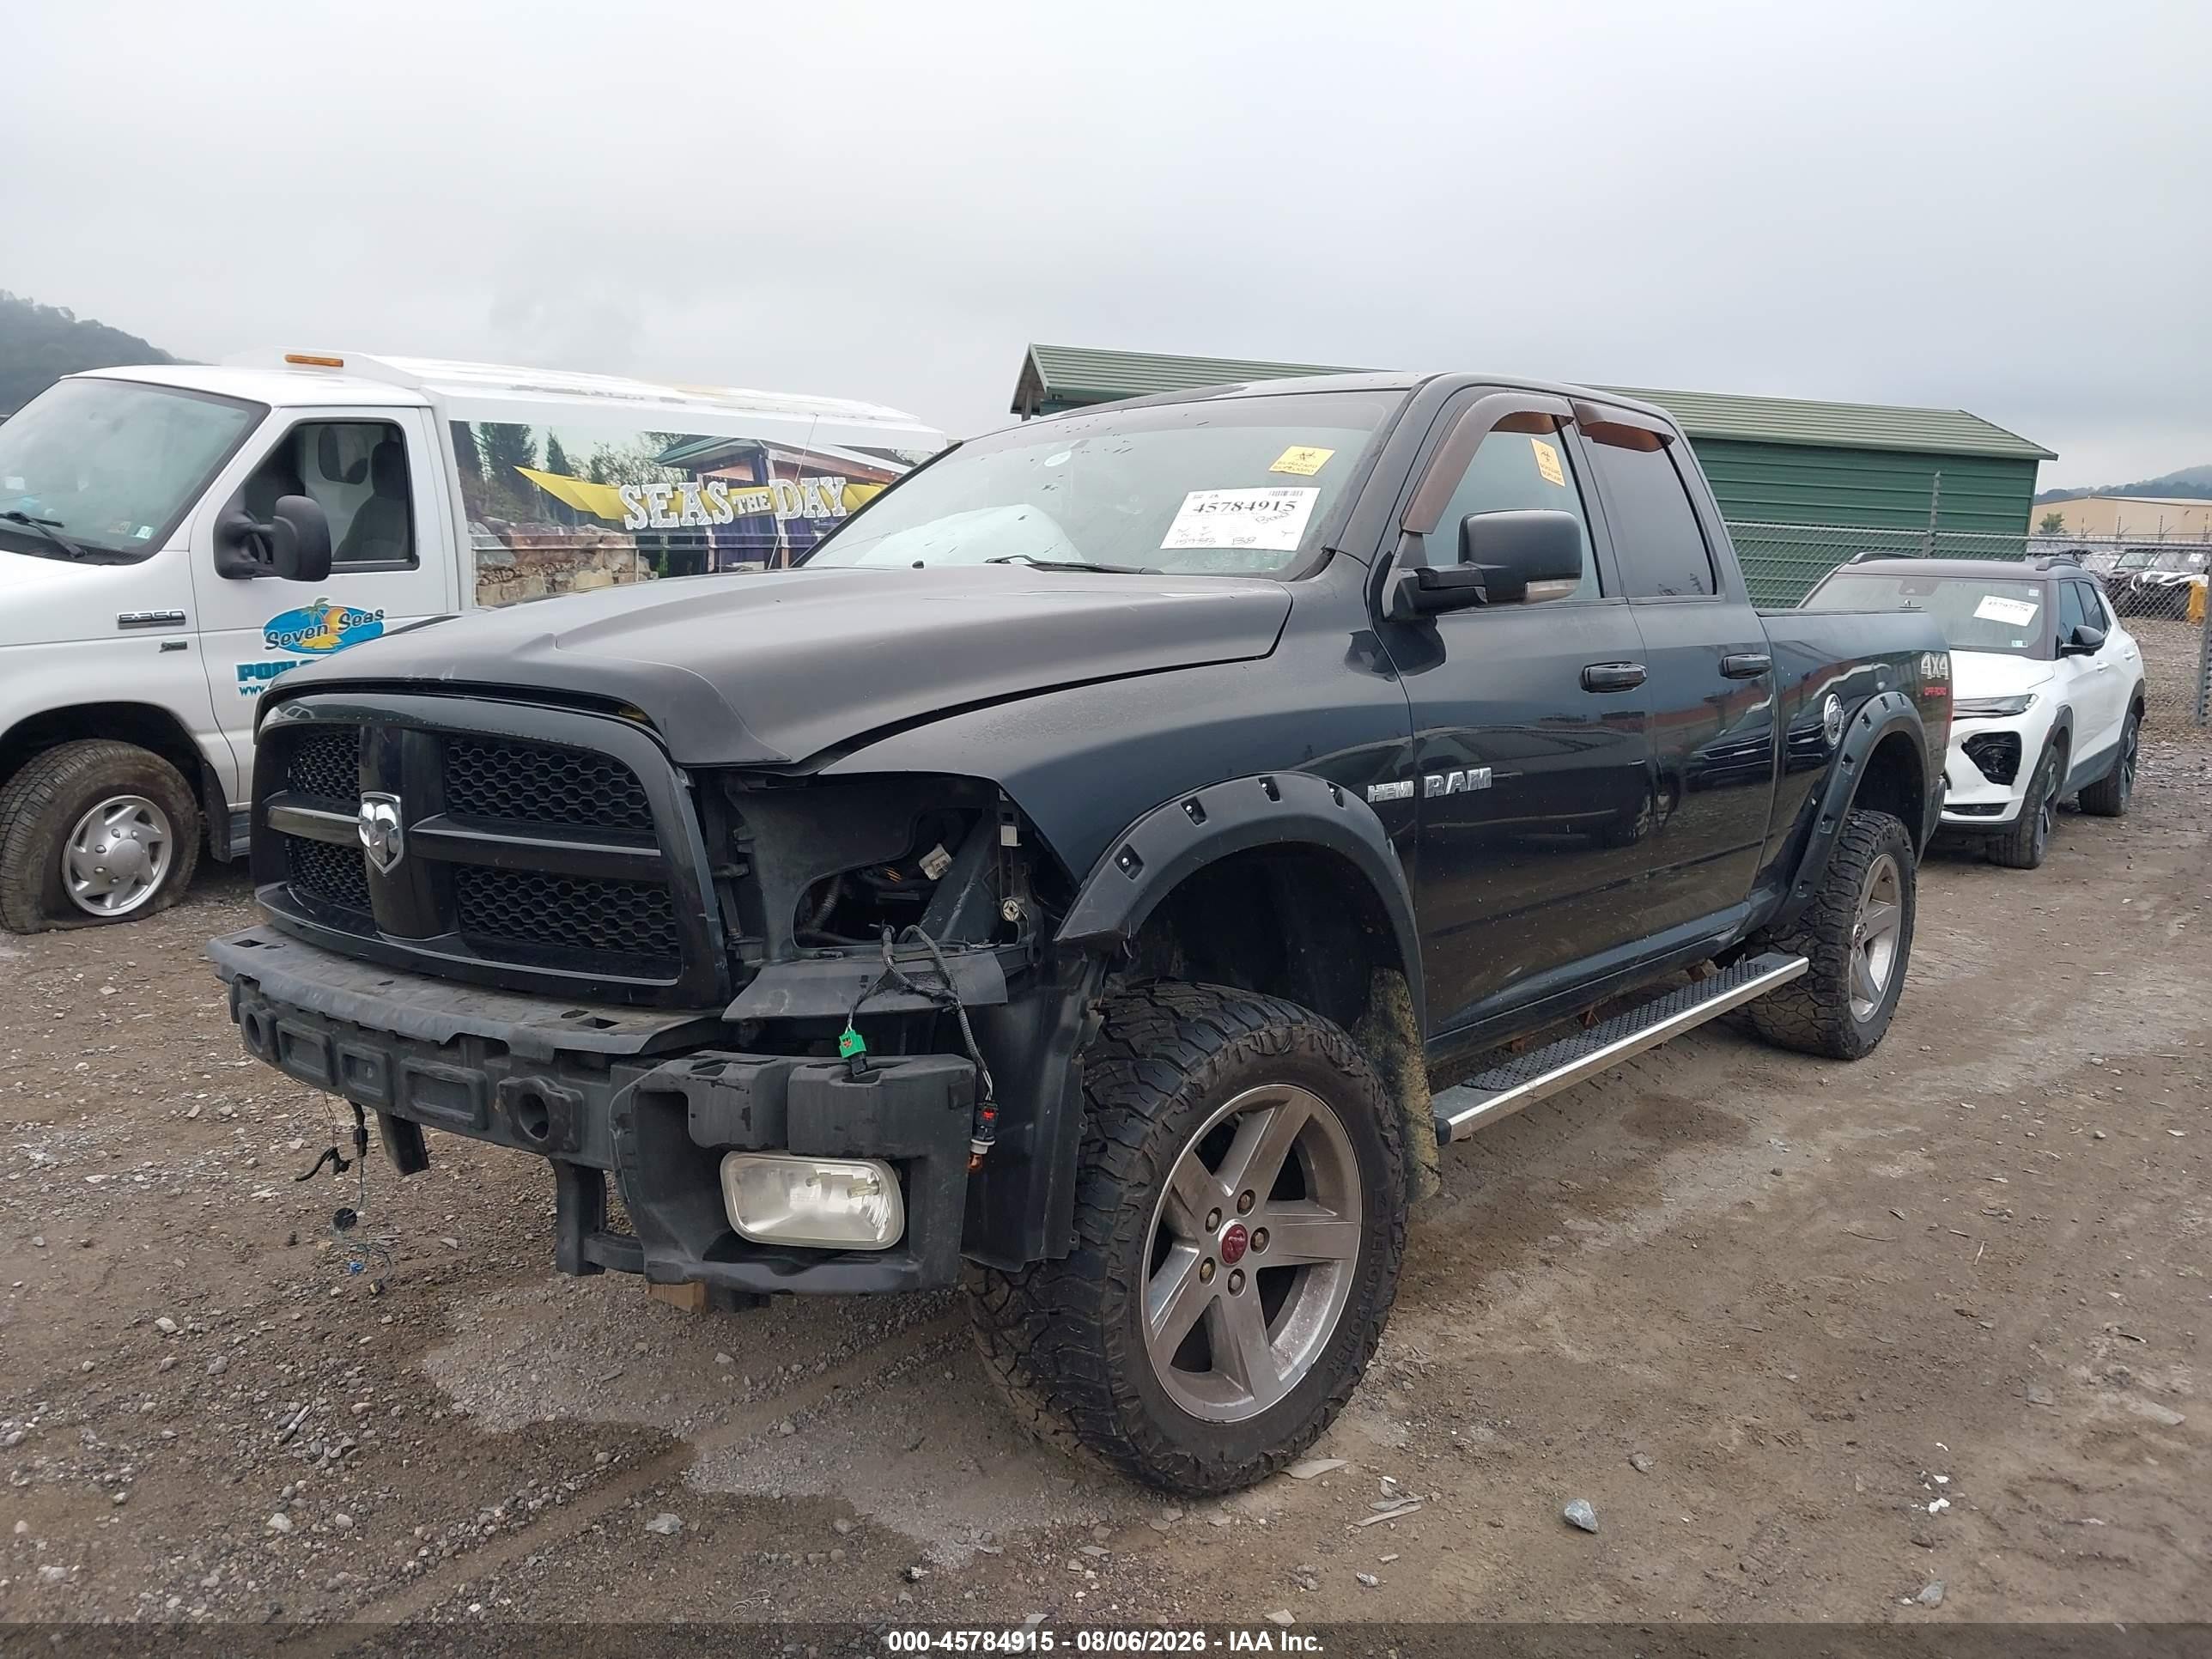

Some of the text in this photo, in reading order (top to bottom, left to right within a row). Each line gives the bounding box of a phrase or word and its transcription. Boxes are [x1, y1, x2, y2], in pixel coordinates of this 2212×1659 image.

[618, 477, 847, 530] SEAS THE DAY
[1193, 500, 1297, 514] 45784915
[264, 609, 385, 650] Seven Seas
[1368, 781, 1414, 803] HEMI
[1424, 767, 1492, 798] RAM
